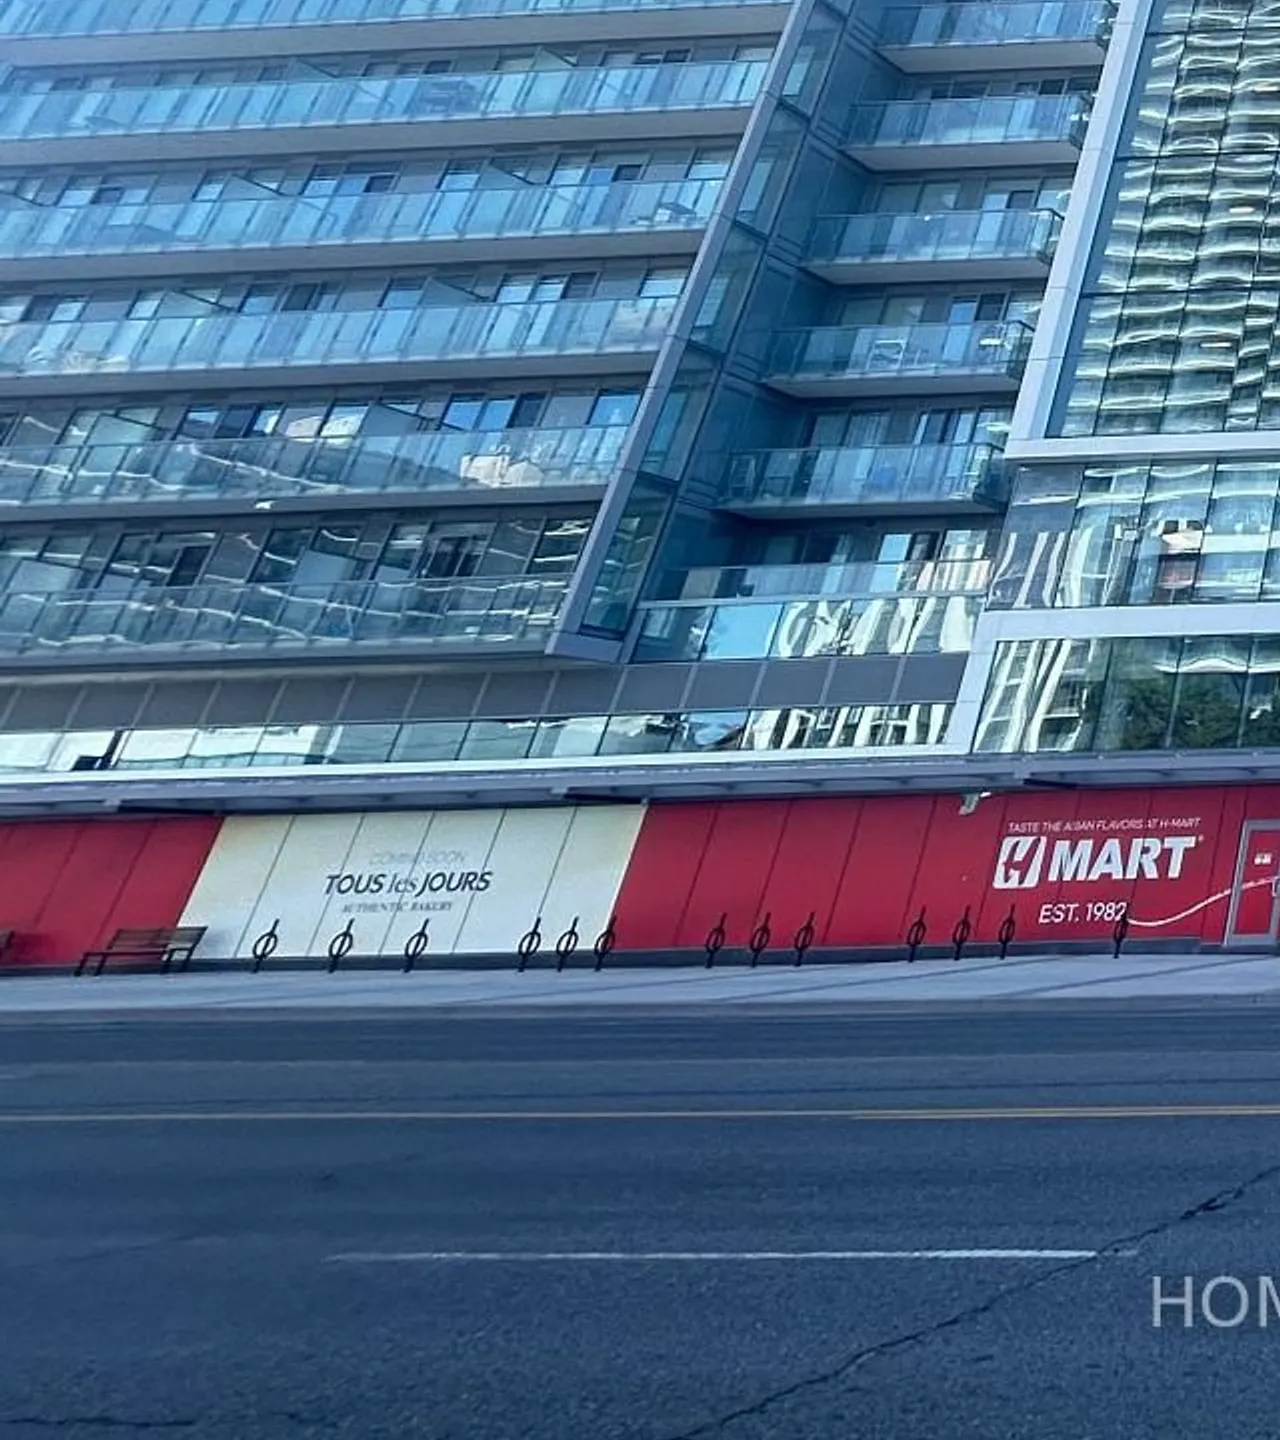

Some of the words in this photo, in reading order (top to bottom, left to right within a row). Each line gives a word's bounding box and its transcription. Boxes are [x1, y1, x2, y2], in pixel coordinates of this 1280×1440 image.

[1008, 821, 1040, 834] TASTE
[1042, 821, 1063, 833] THE
[1063, 820, 1096, 832] ASIAN
[1096, 818, 1145, 831] FLAVORS
[1146, 818, 1160, 830] AT
[1160, 816, 1202, 829] H-MART
[1048, 836, 1197, 881] MART
[325, 873, 387, 895] TOUS
[387, 873, 419, 893] les
[415, 871, 494, 897] JOURS
[1039, 904, 1080, 924] EST.
[1086, 902, 1128, 922] 1982
